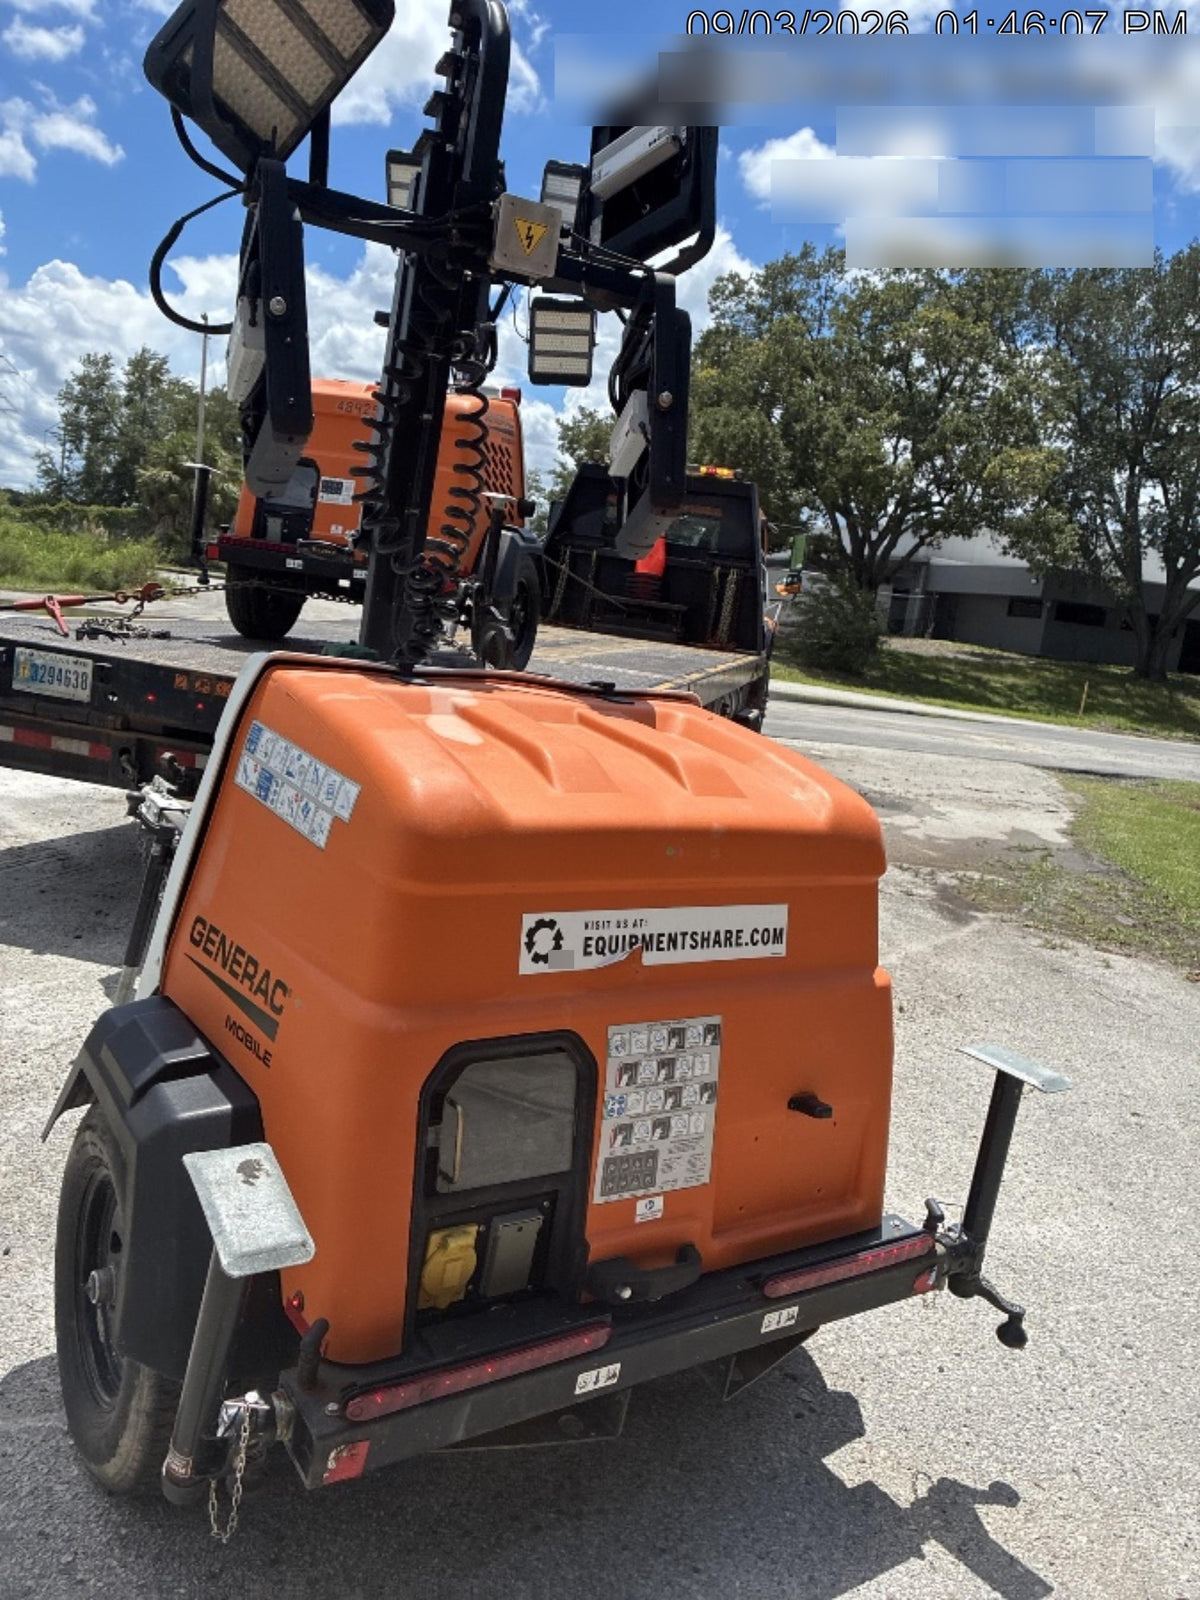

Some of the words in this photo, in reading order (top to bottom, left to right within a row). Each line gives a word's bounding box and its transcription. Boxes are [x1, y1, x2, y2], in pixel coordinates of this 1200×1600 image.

[582, 927, 784, 957] EQUIPMENTSHARE.COM
[584, 920, 612, 931] VISIT
[616, 919, 629, 929] US
[189, 914, 289, 1016] GENERAC
[225, 1014, 273, 1069] MOBILE
